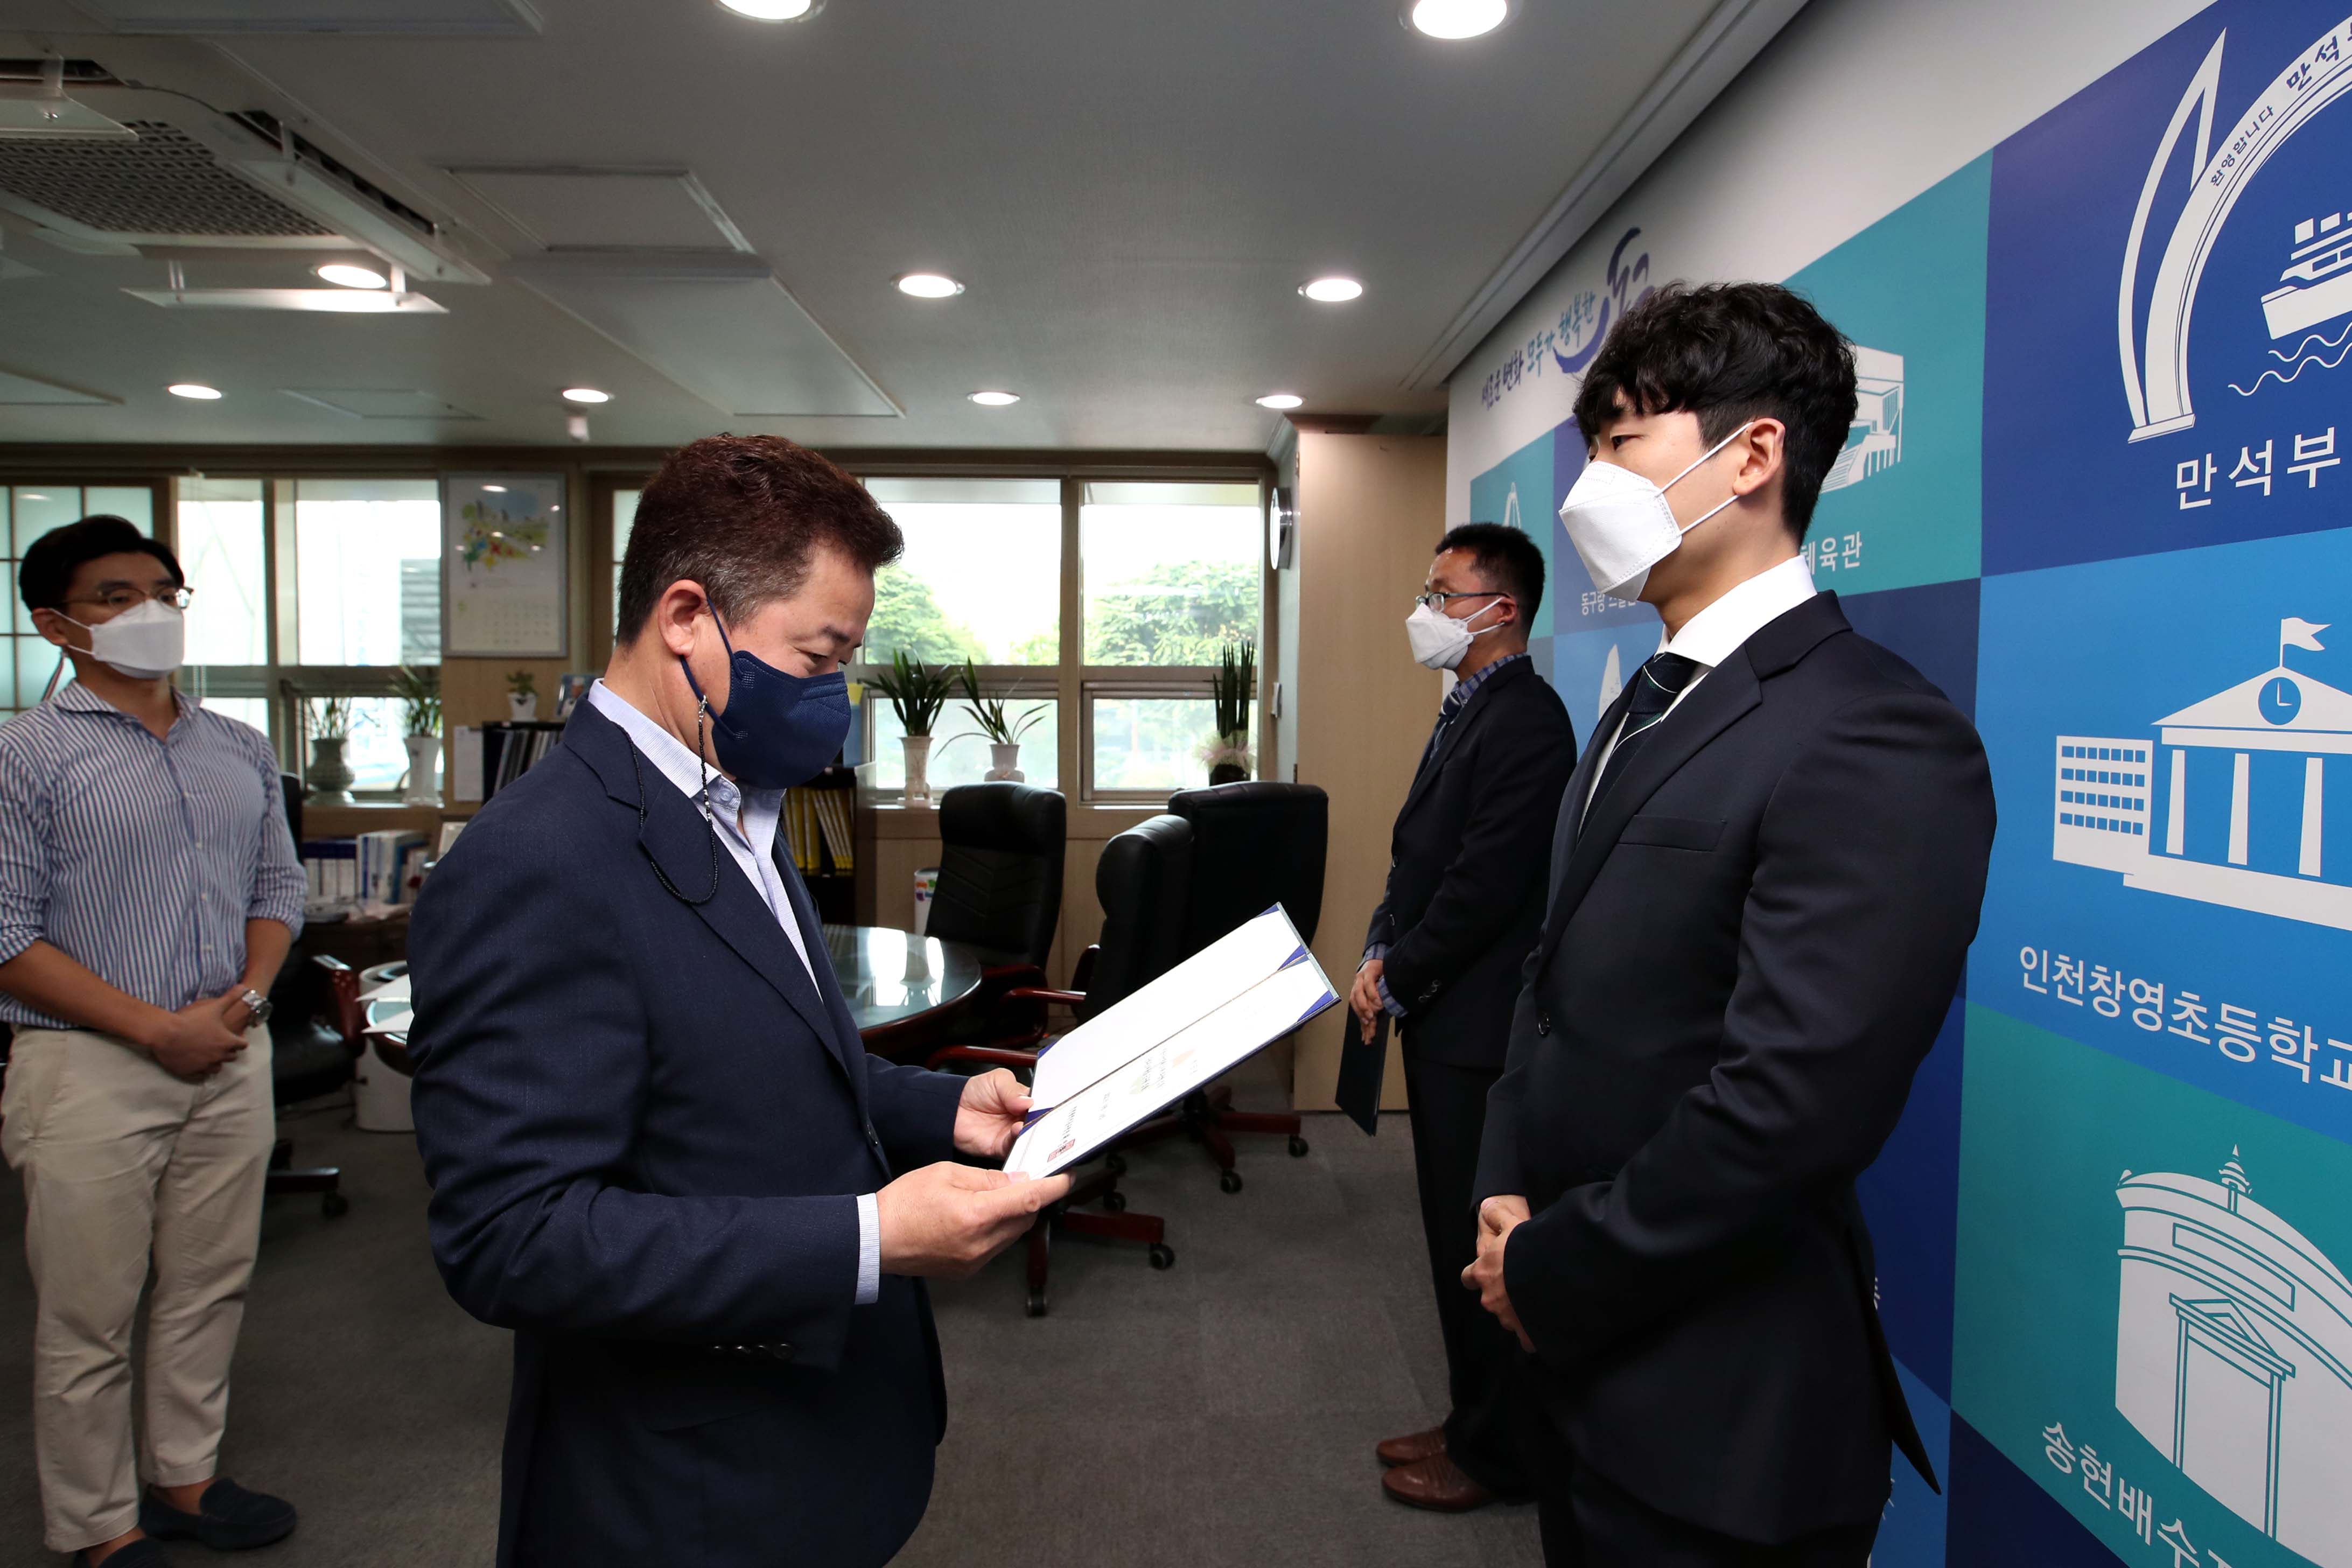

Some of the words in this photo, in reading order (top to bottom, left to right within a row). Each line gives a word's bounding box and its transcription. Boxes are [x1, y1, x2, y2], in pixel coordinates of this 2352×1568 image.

[2286, 22, 2352, 91] 만석
[2210, 106, 2273, 186] 환영합니다
[1528, 330, 1555, 377] 모두가
[1558, 291, 1597, 348] 행복한
[2176, 426, 2341, 510] 만석부
[1800, 531, 1863, 575] 체육관
[1581, 591, 1605, 615] 동구랑
[2042, 1422, 2232, 1568] 송현배수
